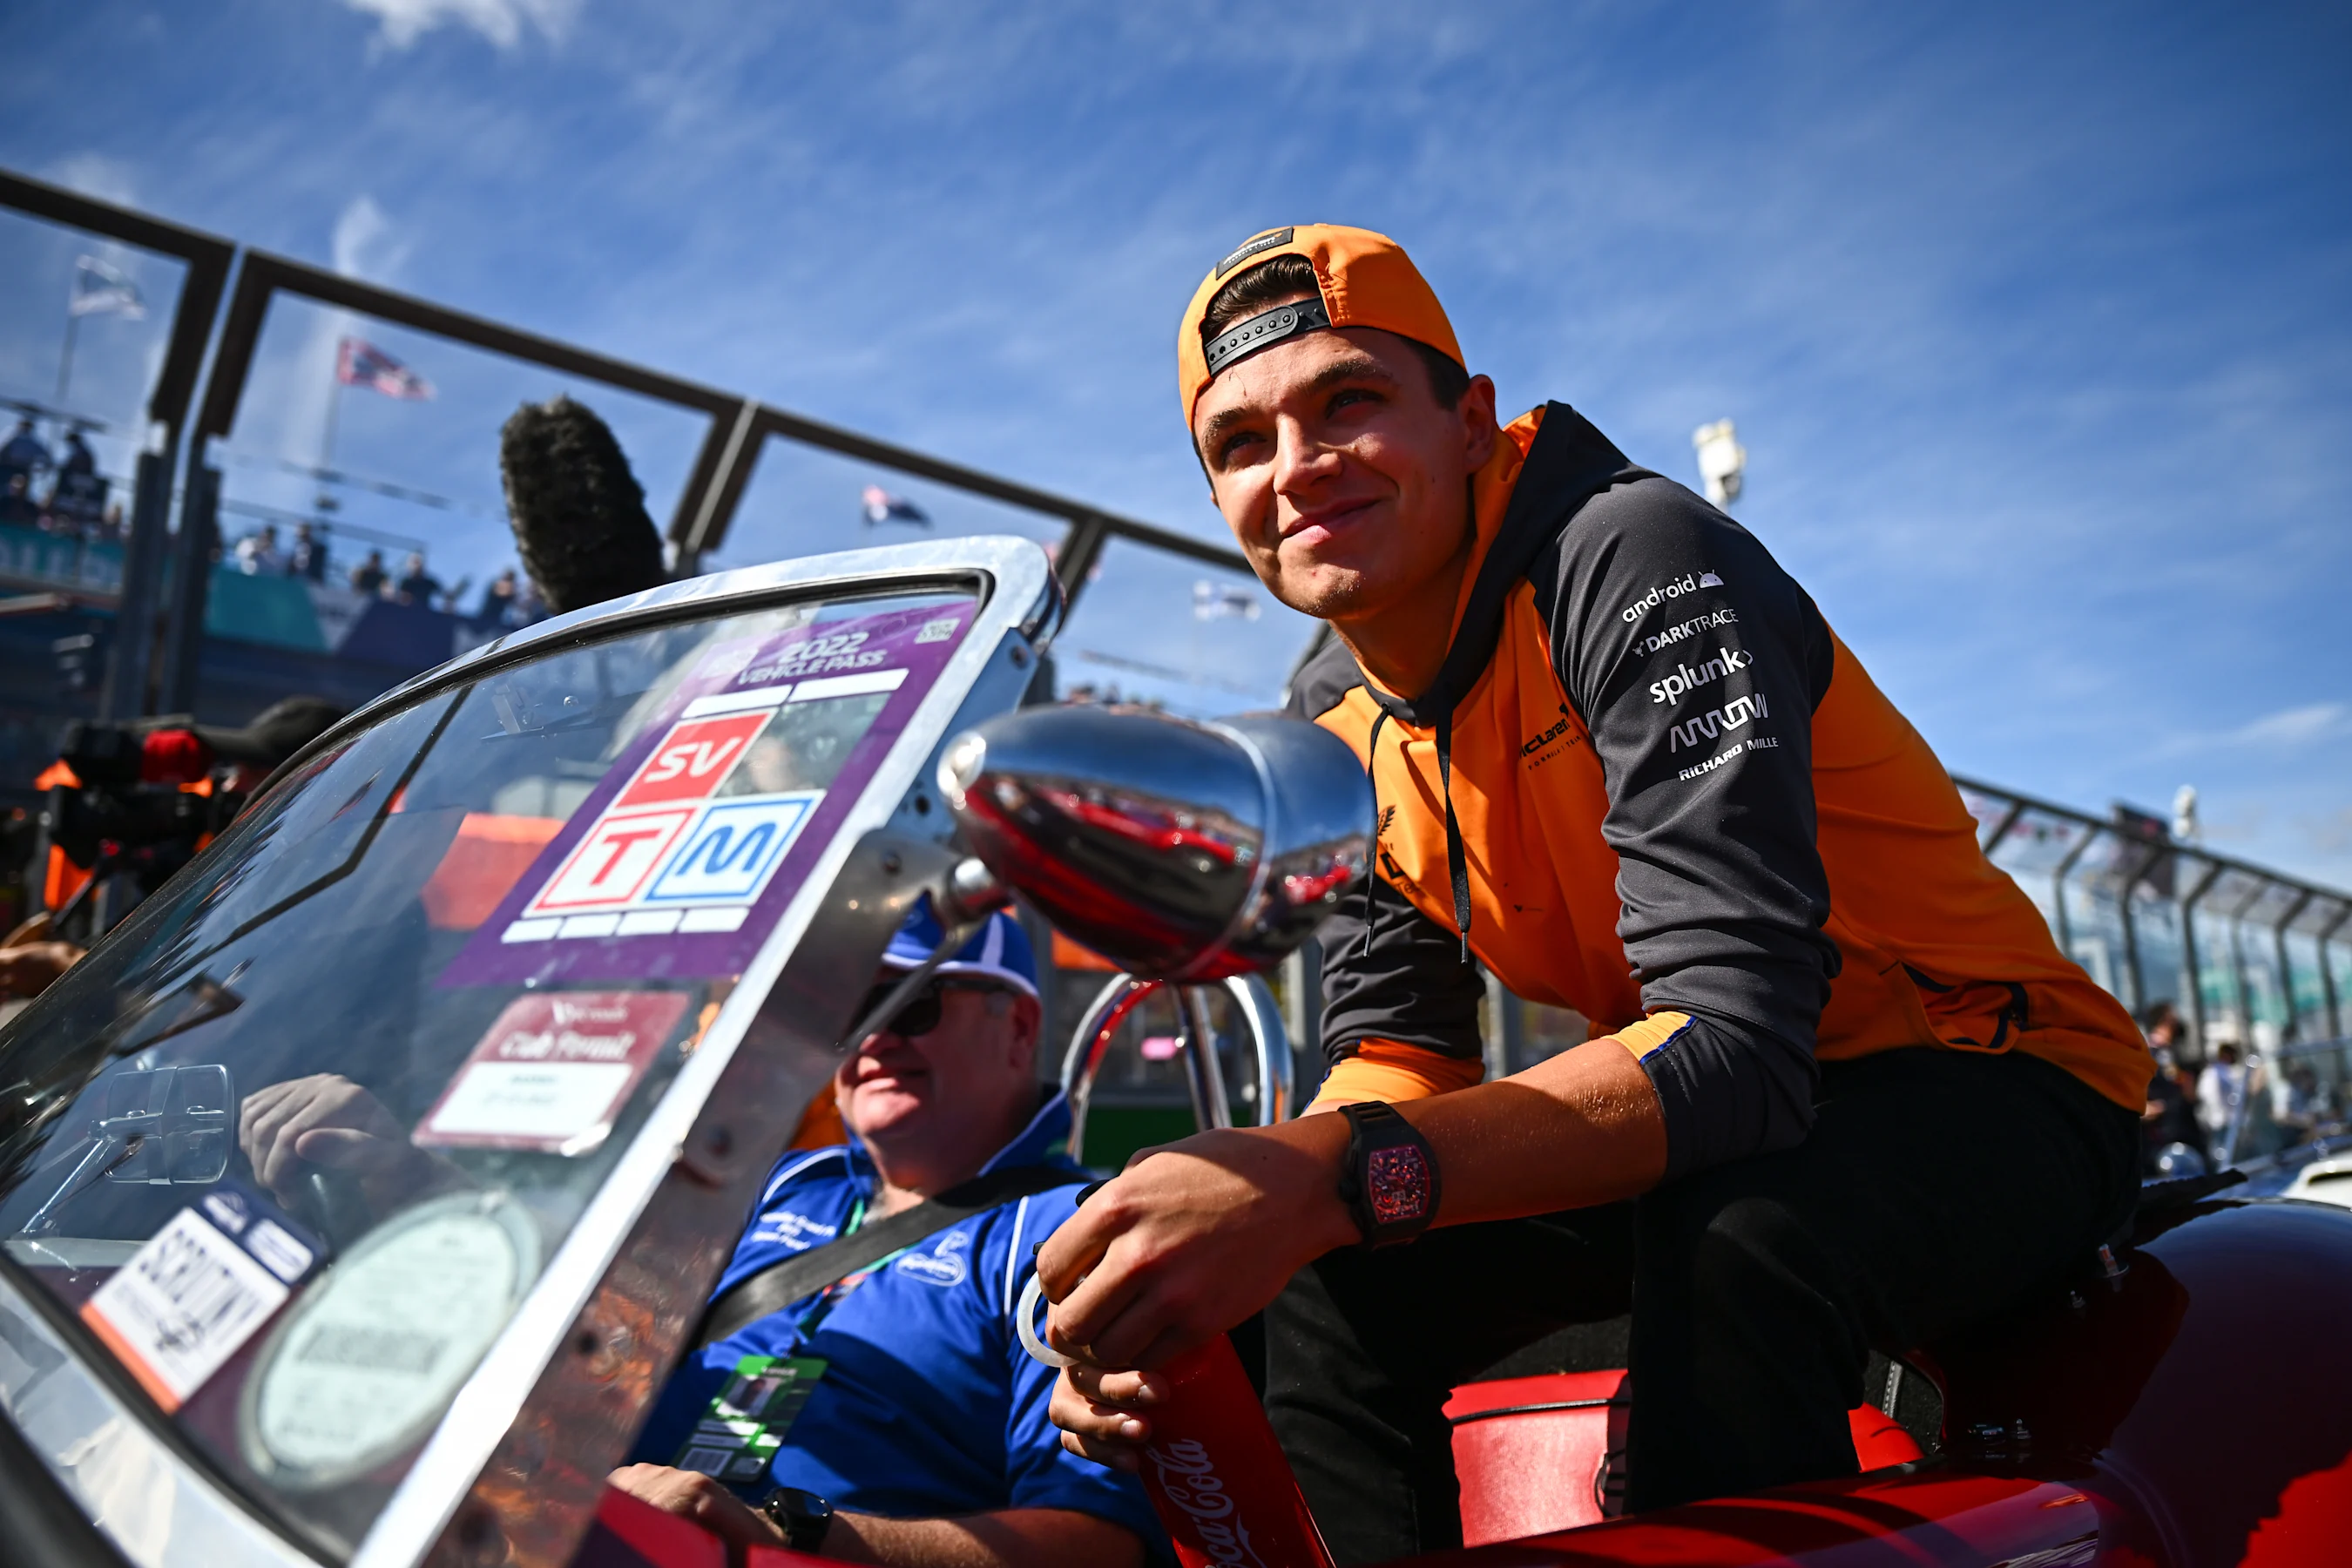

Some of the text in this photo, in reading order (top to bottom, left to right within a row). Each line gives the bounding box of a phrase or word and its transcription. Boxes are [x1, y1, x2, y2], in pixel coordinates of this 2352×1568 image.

[1622, 573, 1697, 623] android
[777, 632, 869, 665] 2022
[1645, 609, 1739, 653] DARKTRACE
[739, 650, 889, 685] VEHICLE PASS
[644, 737, 743, 783] SV
[1678, 737, 1779, 781] RICHARD MILLE
[588, 821, 778, 887] T M
